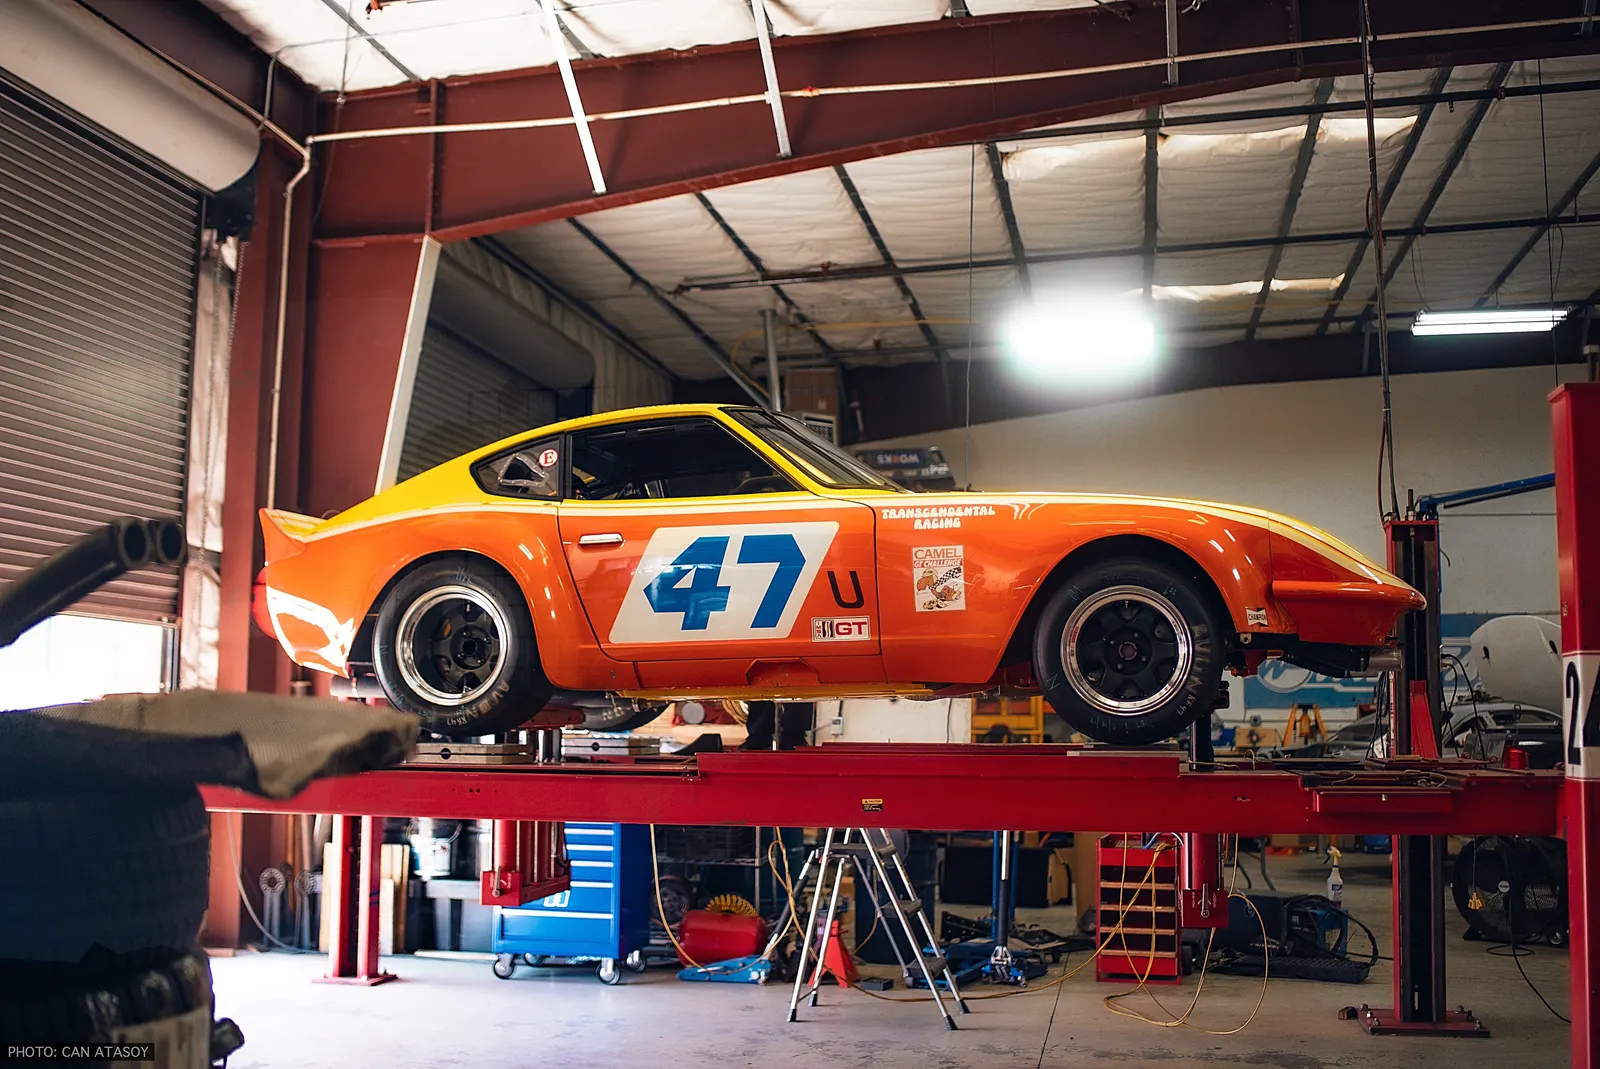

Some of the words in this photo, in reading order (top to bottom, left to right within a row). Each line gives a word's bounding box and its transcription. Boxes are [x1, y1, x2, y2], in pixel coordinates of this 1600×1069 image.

[543, 451, 554, 465] E
[881, 505, 996, 520] TRANSCENDENTAL
[913, 517, 962, 530] RACING
[914, 547, 962, 560] CAMEL
[914, 560, 923, 568] GT
[923, 559, 962, 568] CHALLENGE
[642, 533, 807, 631] 47
[827, 570, 866, 610] U
[835, 621, 868, 636] GT
